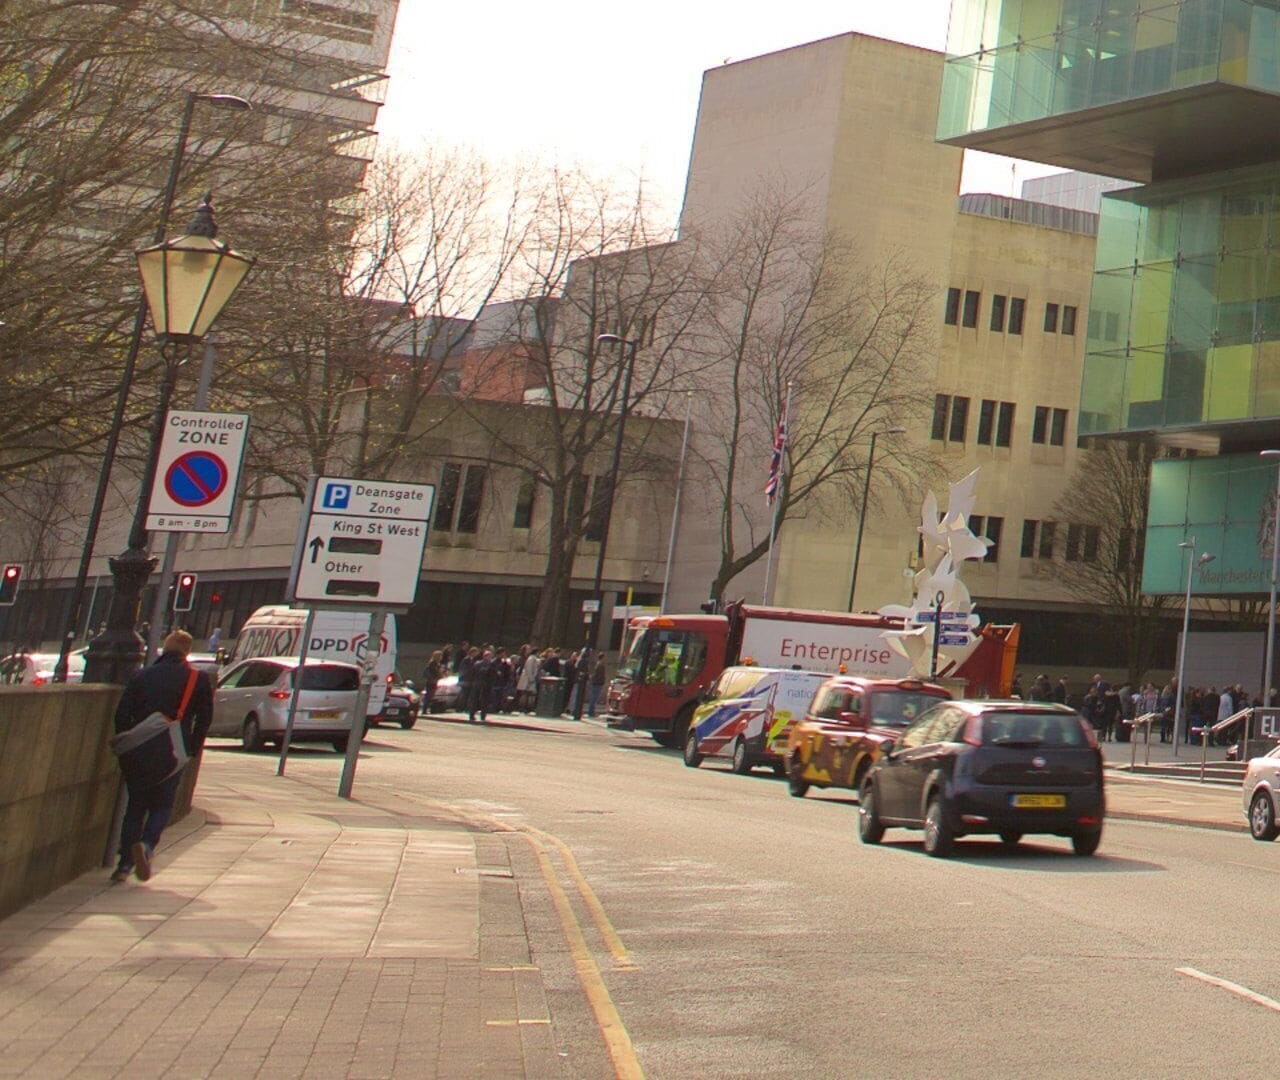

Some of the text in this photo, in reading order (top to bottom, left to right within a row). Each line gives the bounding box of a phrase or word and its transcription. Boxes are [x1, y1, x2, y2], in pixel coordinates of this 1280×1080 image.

[170, 416, 244, 430] Controlled
[179, 431, 229, 445] ZONE
[329, 485, 423, 506] P Deansgate
[369, 502, 401, 515] Zone
[333, 520, 420, 537] King St West
[325, 561, 363, 573] Other
[310, 638, 349, 652] DPD
[780, 638, 891, 665] Enterprise
